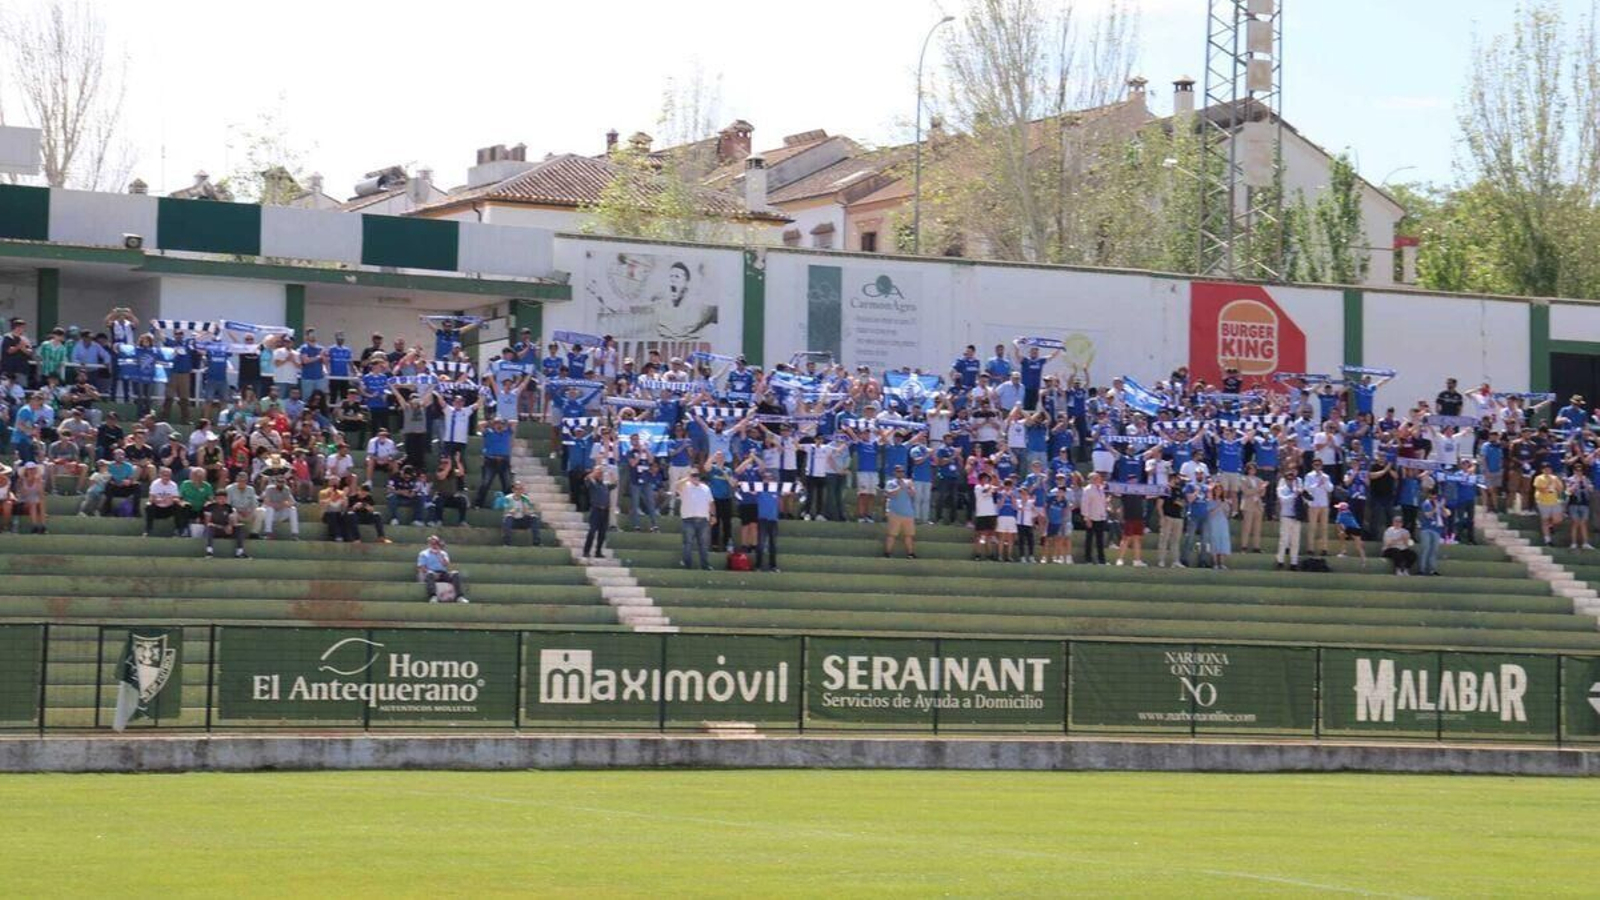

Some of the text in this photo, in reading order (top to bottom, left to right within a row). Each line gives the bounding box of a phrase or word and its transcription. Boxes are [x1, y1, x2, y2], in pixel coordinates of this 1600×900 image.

[1221, 322, 1274, 338] BURGER
[1221, 338, 1274, 359] KING
[389, 653, 478, 678] Horno
[822, 655, 1050, 691] SERAINANT
[1170, 664, 1223, 676] ONLINE
[253, 674, 477, 707] El Antequerano
[822, 692, 1043, 712] Servicios de Ayuda a Domicilio
[1354, 659, 1527, 722] MALABAR
